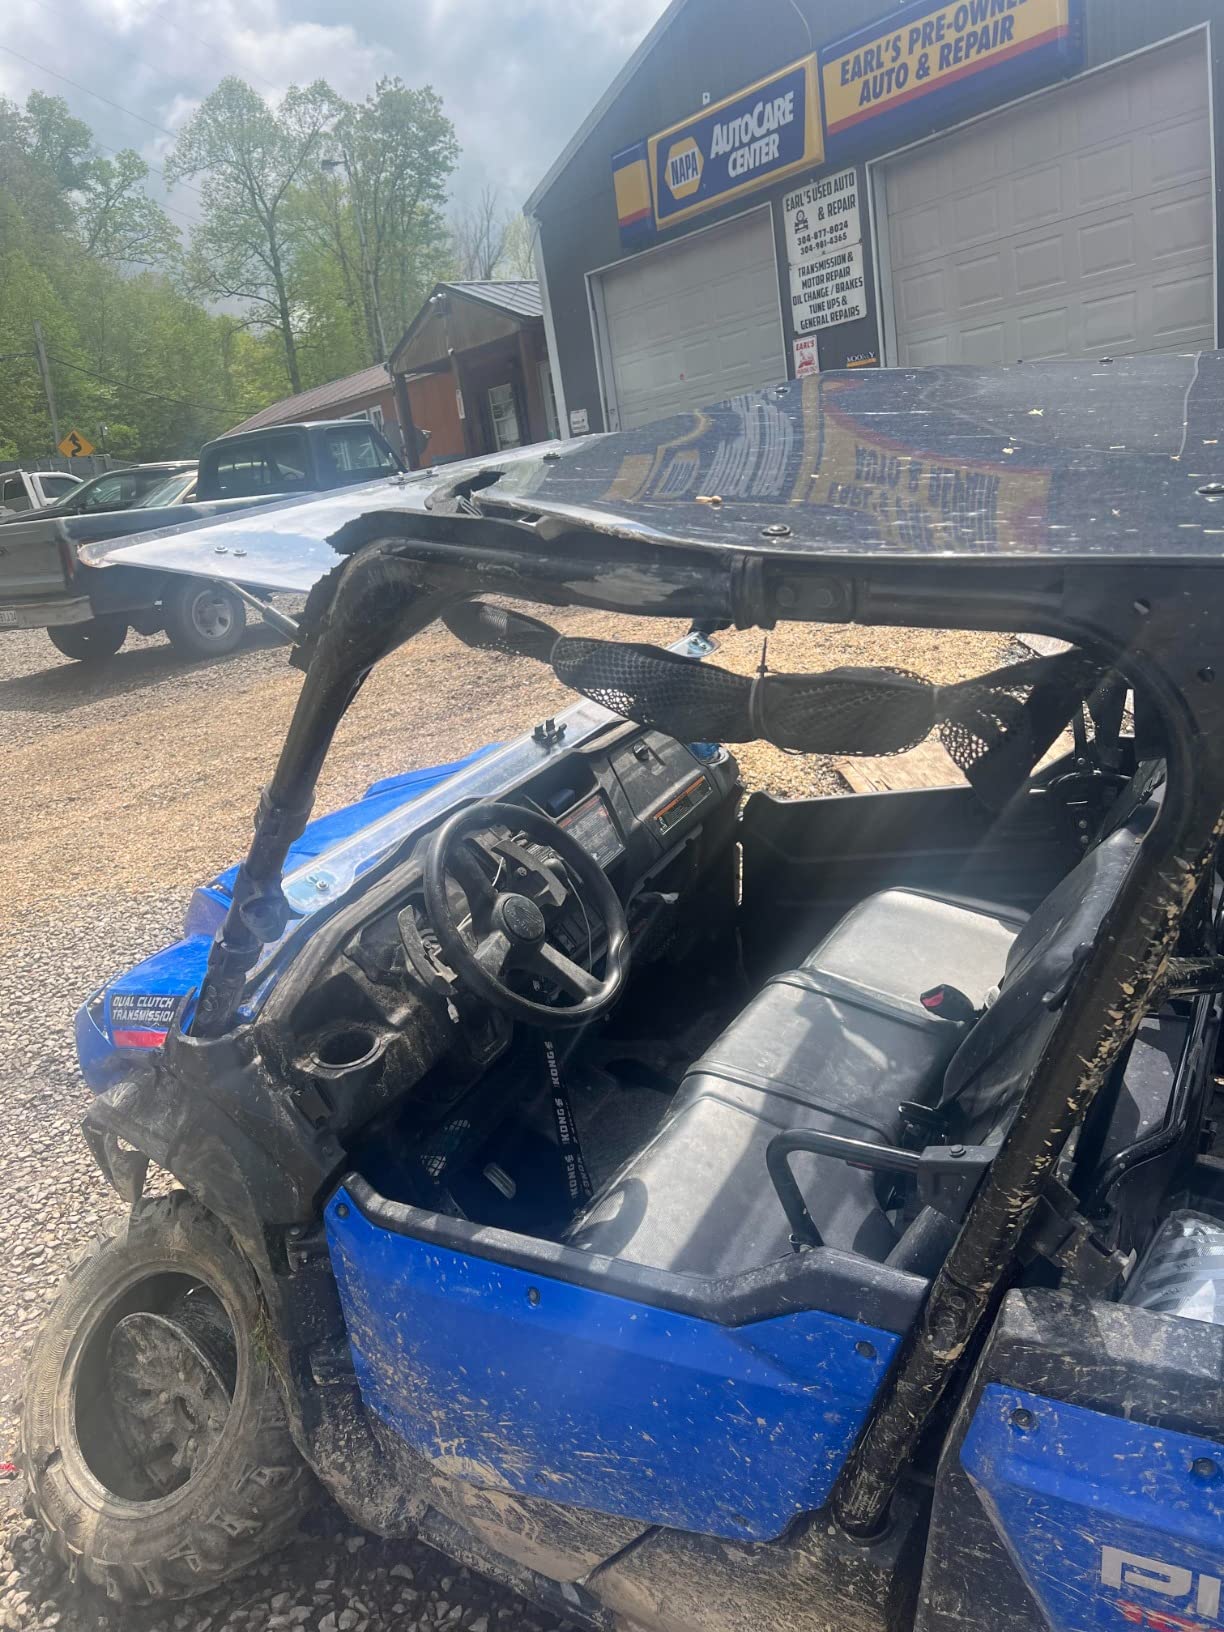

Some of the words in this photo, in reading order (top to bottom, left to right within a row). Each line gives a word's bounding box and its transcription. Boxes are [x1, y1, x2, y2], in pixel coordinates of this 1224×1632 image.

[840, 34, 901, 87] EARL'S
[908, 0, 1028, 56] PRE-OWN
[858, 62, 909, 107] AUTO
[915, 52, 931, 80] &
[938, 14, 1015, 72] REPAIR
[670, 150, 699, 187] NAPA
[727, 132, 780, 178] CENTER
[785, 189, 812, 213] EARL'S
[812, 182, 832, 202] USED
[833, 172, 855, 194] AUTO
[817, 206, 825, 221] &
[827, 194, 856, 217] REPAIR
[798, 253, 847, 278] TRANSMISSION
[847, 251, 854, 263] &
[802, 276, 825, 290] MOTOR
[826, 266, 851, 283] REPAIR
[792, 294, 803, 306] OIL
[803, 286, 829, 303] CHANGE
[835, 276, 863, 294] BRAKES
[809, 301, 826, 315] TUNE
[826, 296, 841, 310] UPS
[841, 295, 848, 306] &
[800, 313, 830, 330] GENERAL
[829, 305, 860, 323] REPAIRS
[112, 996, 135, 1007] DUAL
[137, 997, 175, 1009] CLUTCH
